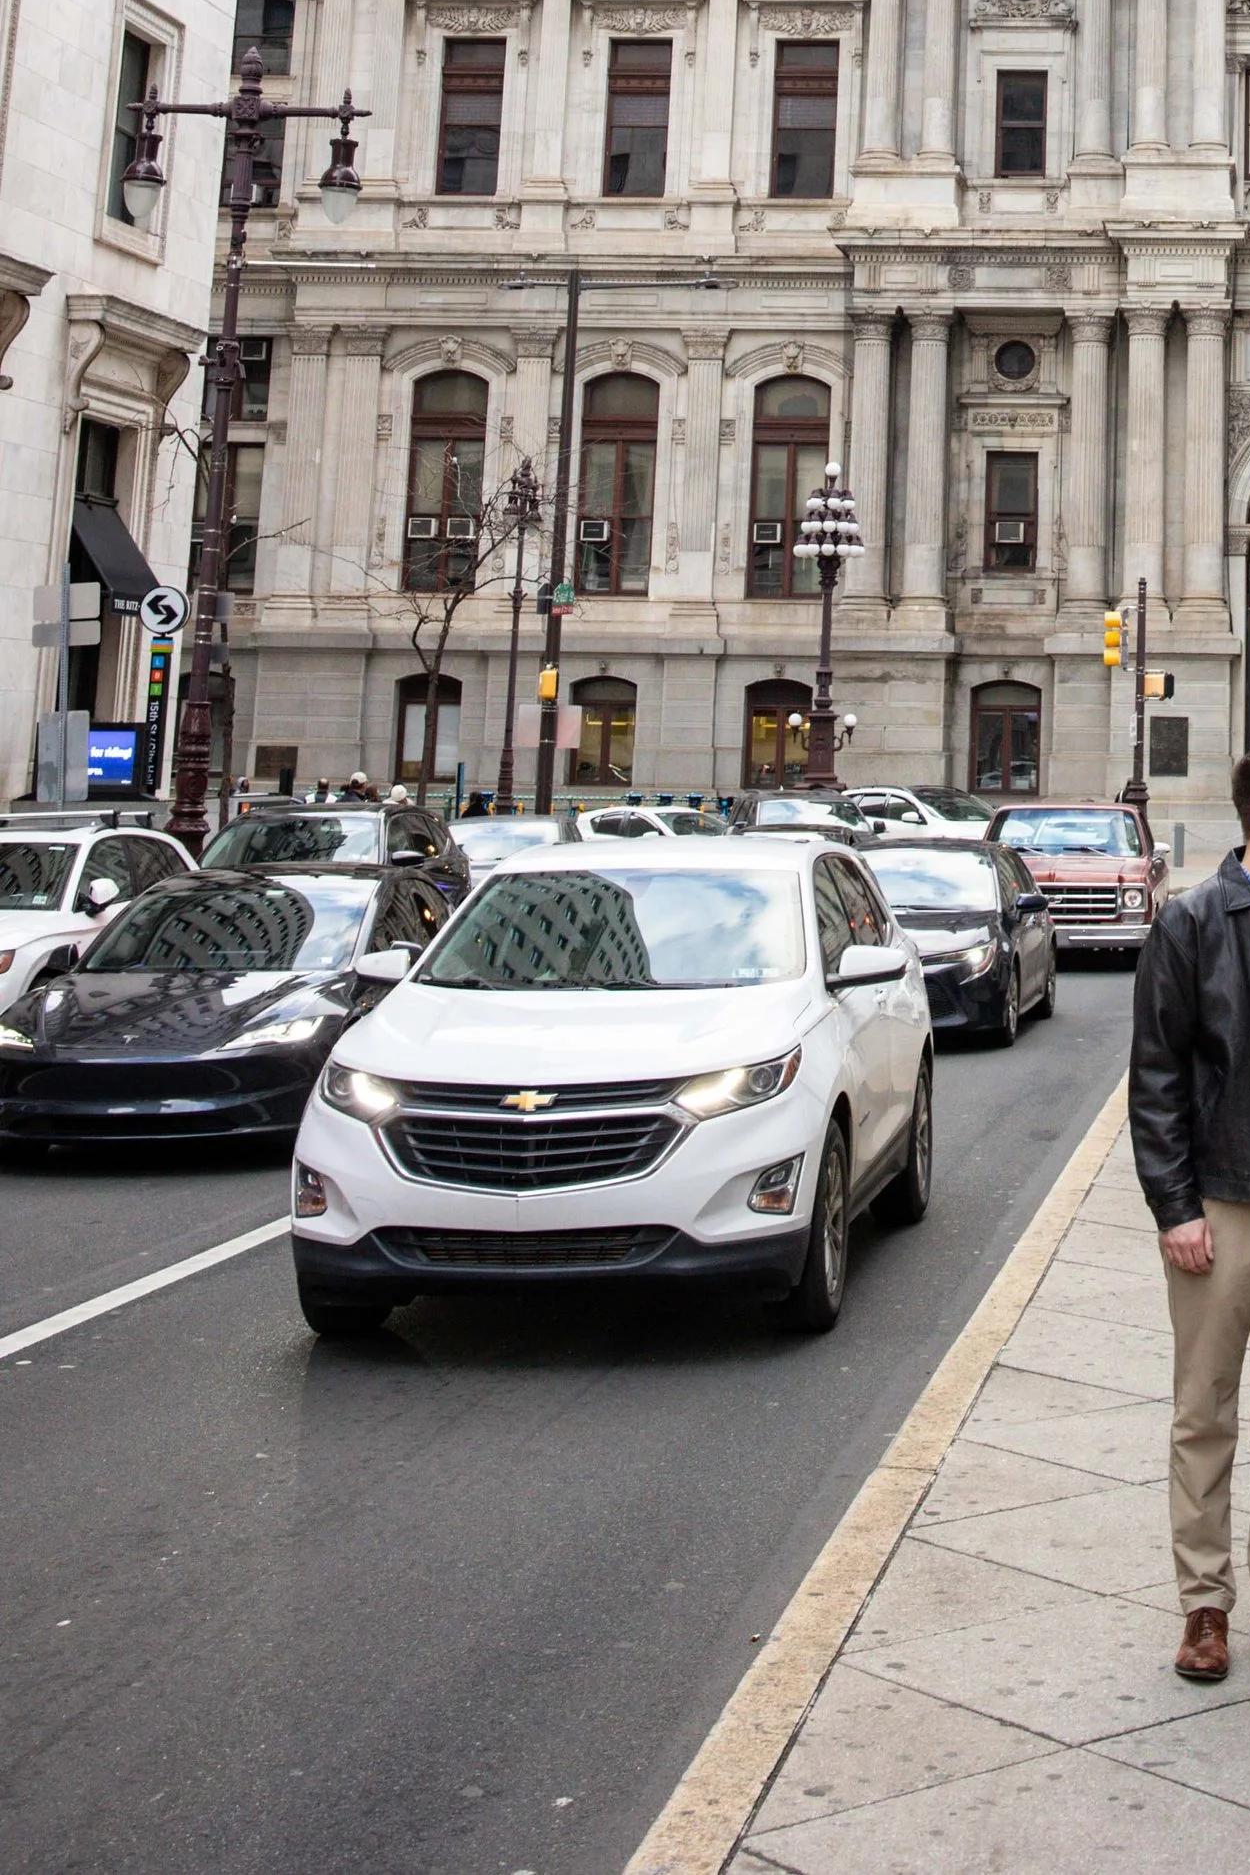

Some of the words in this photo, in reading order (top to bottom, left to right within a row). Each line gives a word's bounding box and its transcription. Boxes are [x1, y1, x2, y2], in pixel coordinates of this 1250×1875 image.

[114, 598, 125, 610] THE
[149, 701, 159, 722] 15th
[150, 724, 157, 734] St
